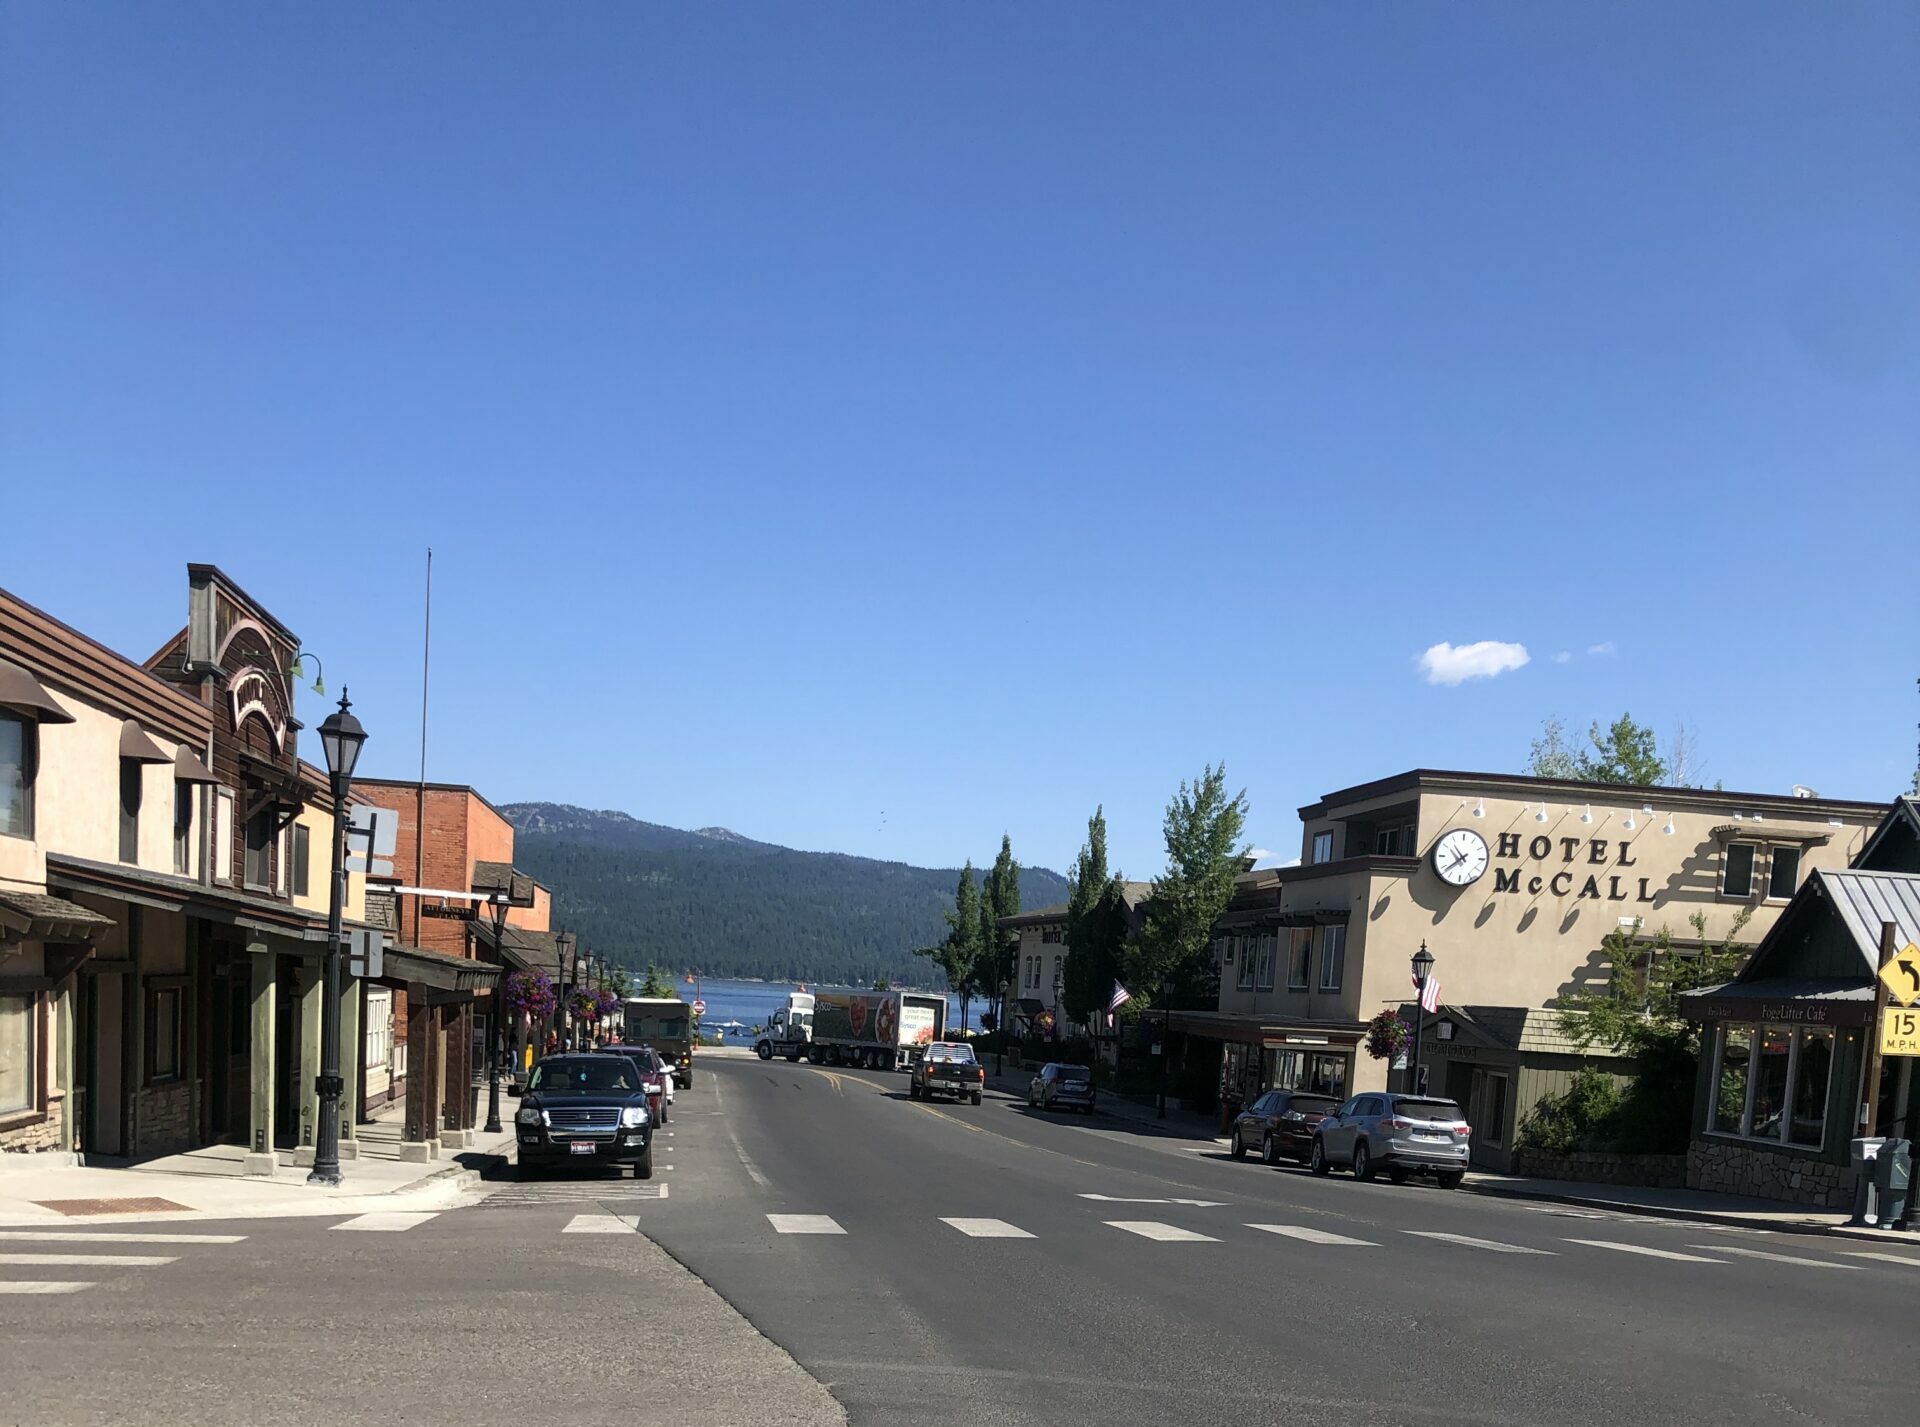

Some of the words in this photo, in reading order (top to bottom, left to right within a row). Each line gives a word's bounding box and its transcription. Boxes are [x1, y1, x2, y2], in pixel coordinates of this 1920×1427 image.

[1496, 832, 1637, 867] HOTEL
[1492, 868, 1656, 902] McCALL
[1894, 1013, 1915, 1036] 15
